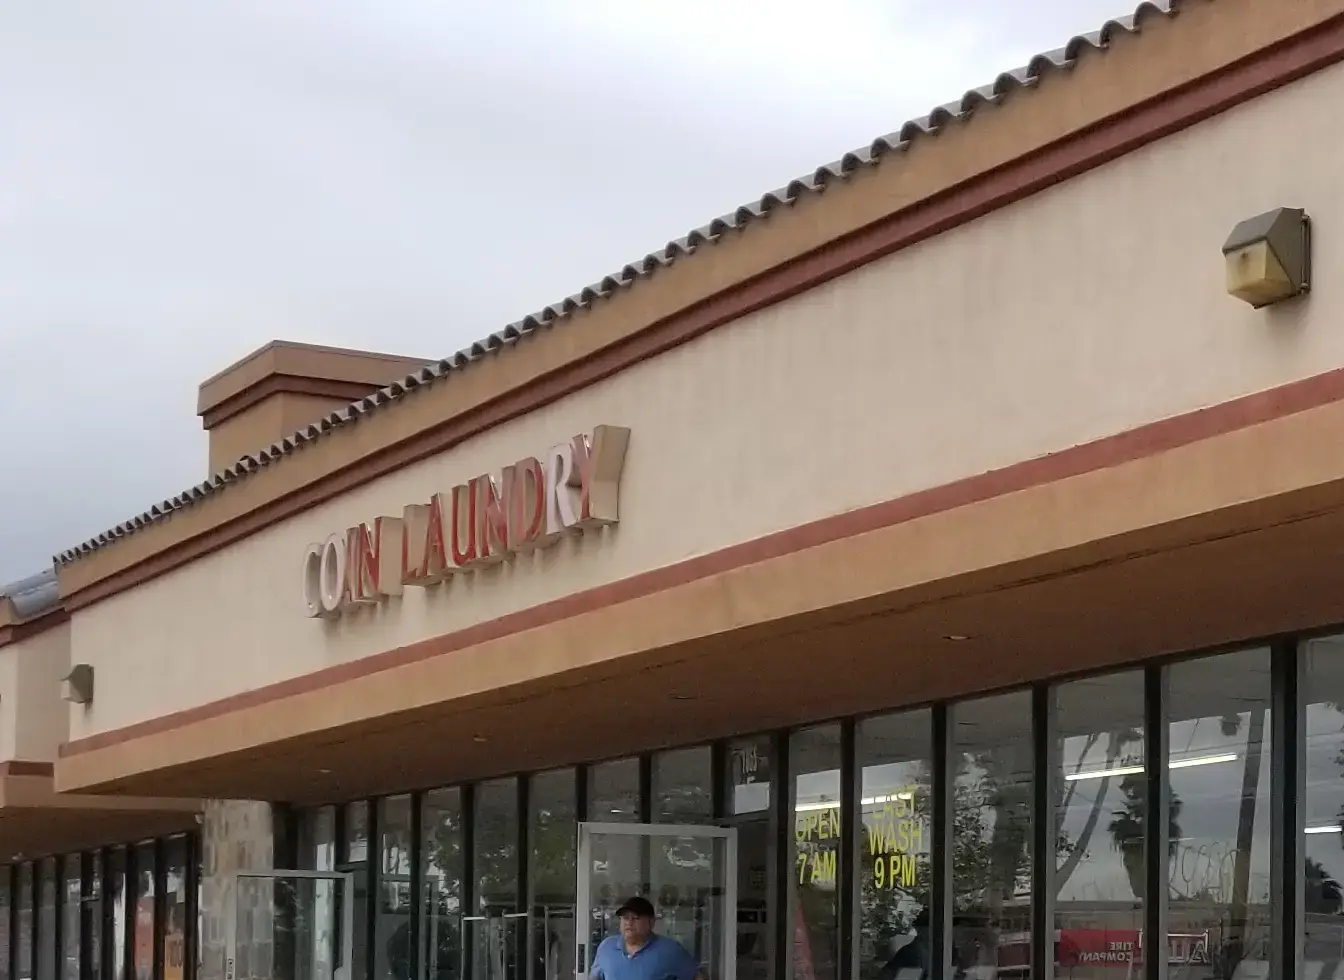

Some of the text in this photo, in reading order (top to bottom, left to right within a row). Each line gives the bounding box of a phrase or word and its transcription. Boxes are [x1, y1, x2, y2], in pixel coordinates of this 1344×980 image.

[303, 425, 629, 618] COIN LAUNDRY
[796, 808, 840, 841] OPEN
[868, 818, 923, 856] WASH
[799, 850, 836, 884] 7 AM
[874, 855, 916, 889] 9 PM
